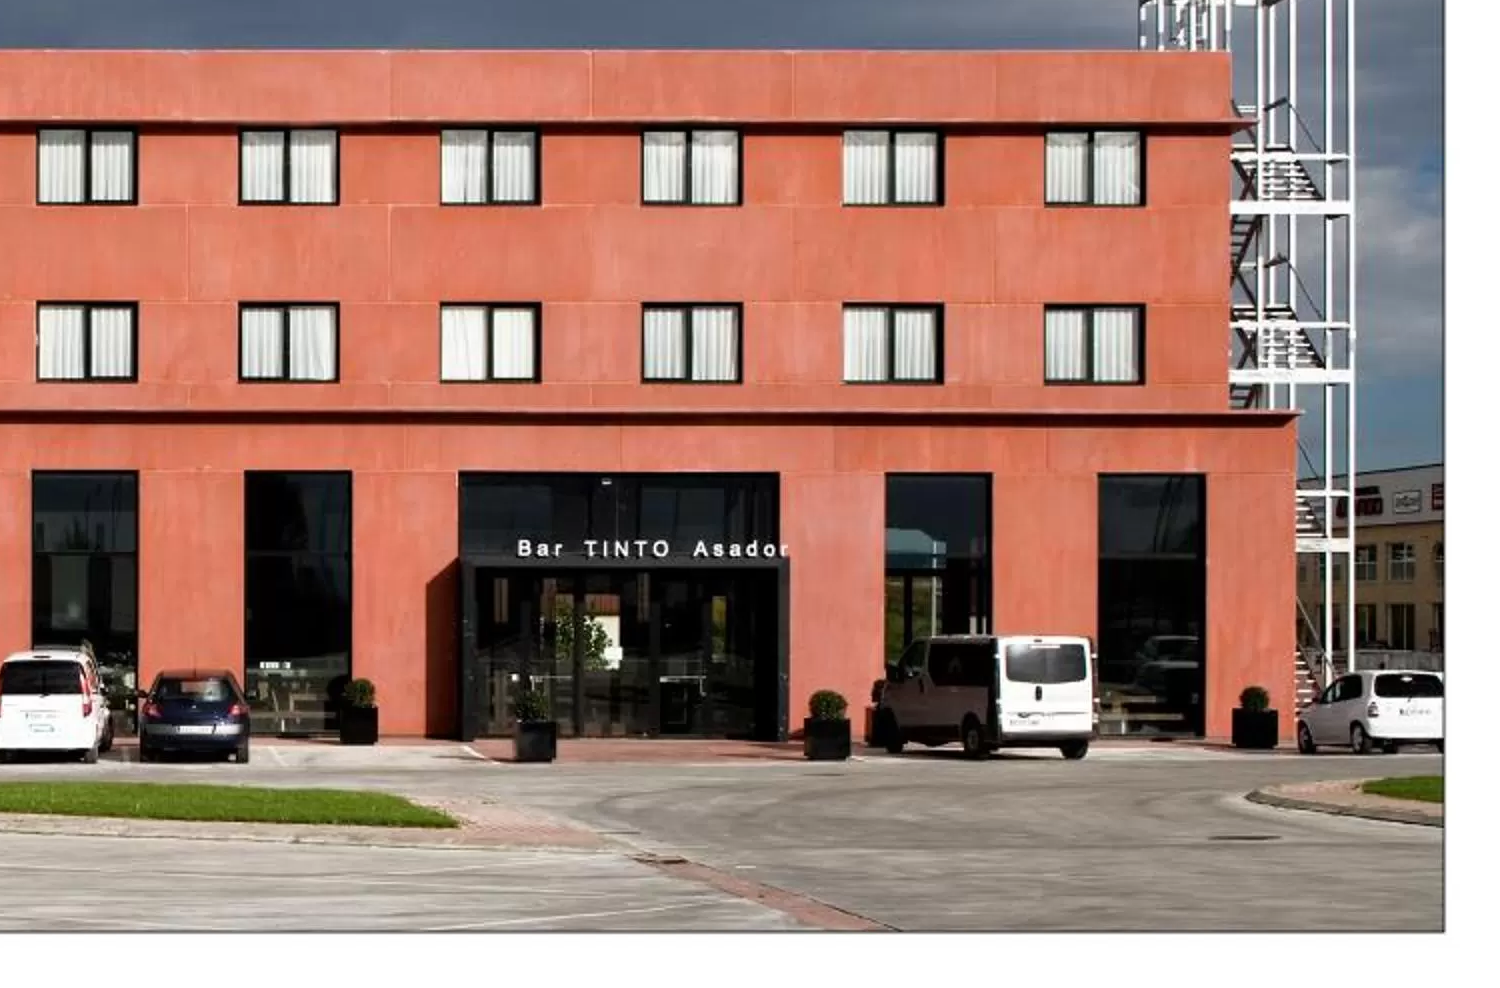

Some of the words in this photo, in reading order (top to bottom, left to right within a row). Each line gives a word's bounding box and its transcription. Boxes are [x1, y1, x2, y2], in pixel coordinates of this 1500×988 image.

[517, 539, 564, 558] Bar
[583, 539, 670, 558] TINTO
[693, 539, 790, 558] Asador
